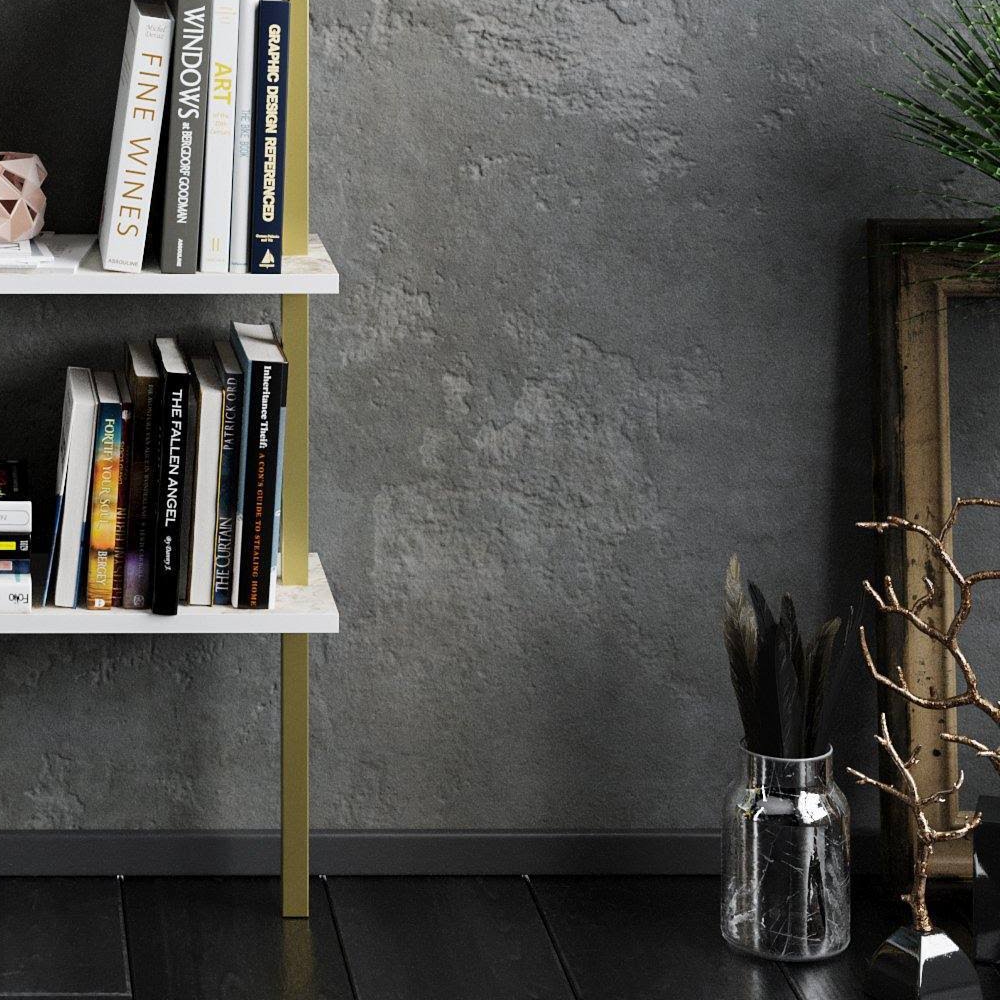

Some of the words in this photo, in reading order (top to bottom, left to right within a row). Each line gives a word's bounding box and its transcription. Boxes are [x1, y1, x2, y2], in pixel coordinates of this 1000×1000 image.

[177, 5, 206, 119] WINDOWS
[266, 24, 281, 83] GRAPHIC
[133, 53, 163, 121] FINE
[213, 62, 233, 105] ART
[182, 122, 191, 130] at
[265, 85, 279, 134] DESIGN
[180, 130, 193, 176] BERGDORF
[117, 137, 151, 237] WINES
[176, 177, 190, 224] GOODMAN
[262, 137, 277, 222] REFERENCED
[108, 258, 138, 267] ASSOULINE
[171, 389, 183, 418] THE
[226, 377, 238, 401] ORD
[260, 365, 272, 420] Inheritance
[102, 418, 116, 461] FORTIFY
[168, 421, 182, 475] FALLEN
[223, 407, 237, 450] PATRICK
[99, 462, 113, 497] YOUR
[97, 499, 110, 532] SOUL
[165, 478, 179, 527] ANGEL
[216, 517, 233, 568] CURTAIN
[255, 520, 262, 532] TO
[96, 551, 108, 585] BERGEY
[252, 535, 261, 578] STEALING
[215, 569, 230, 592] THE
[250, 580, 259, 607] HOME
